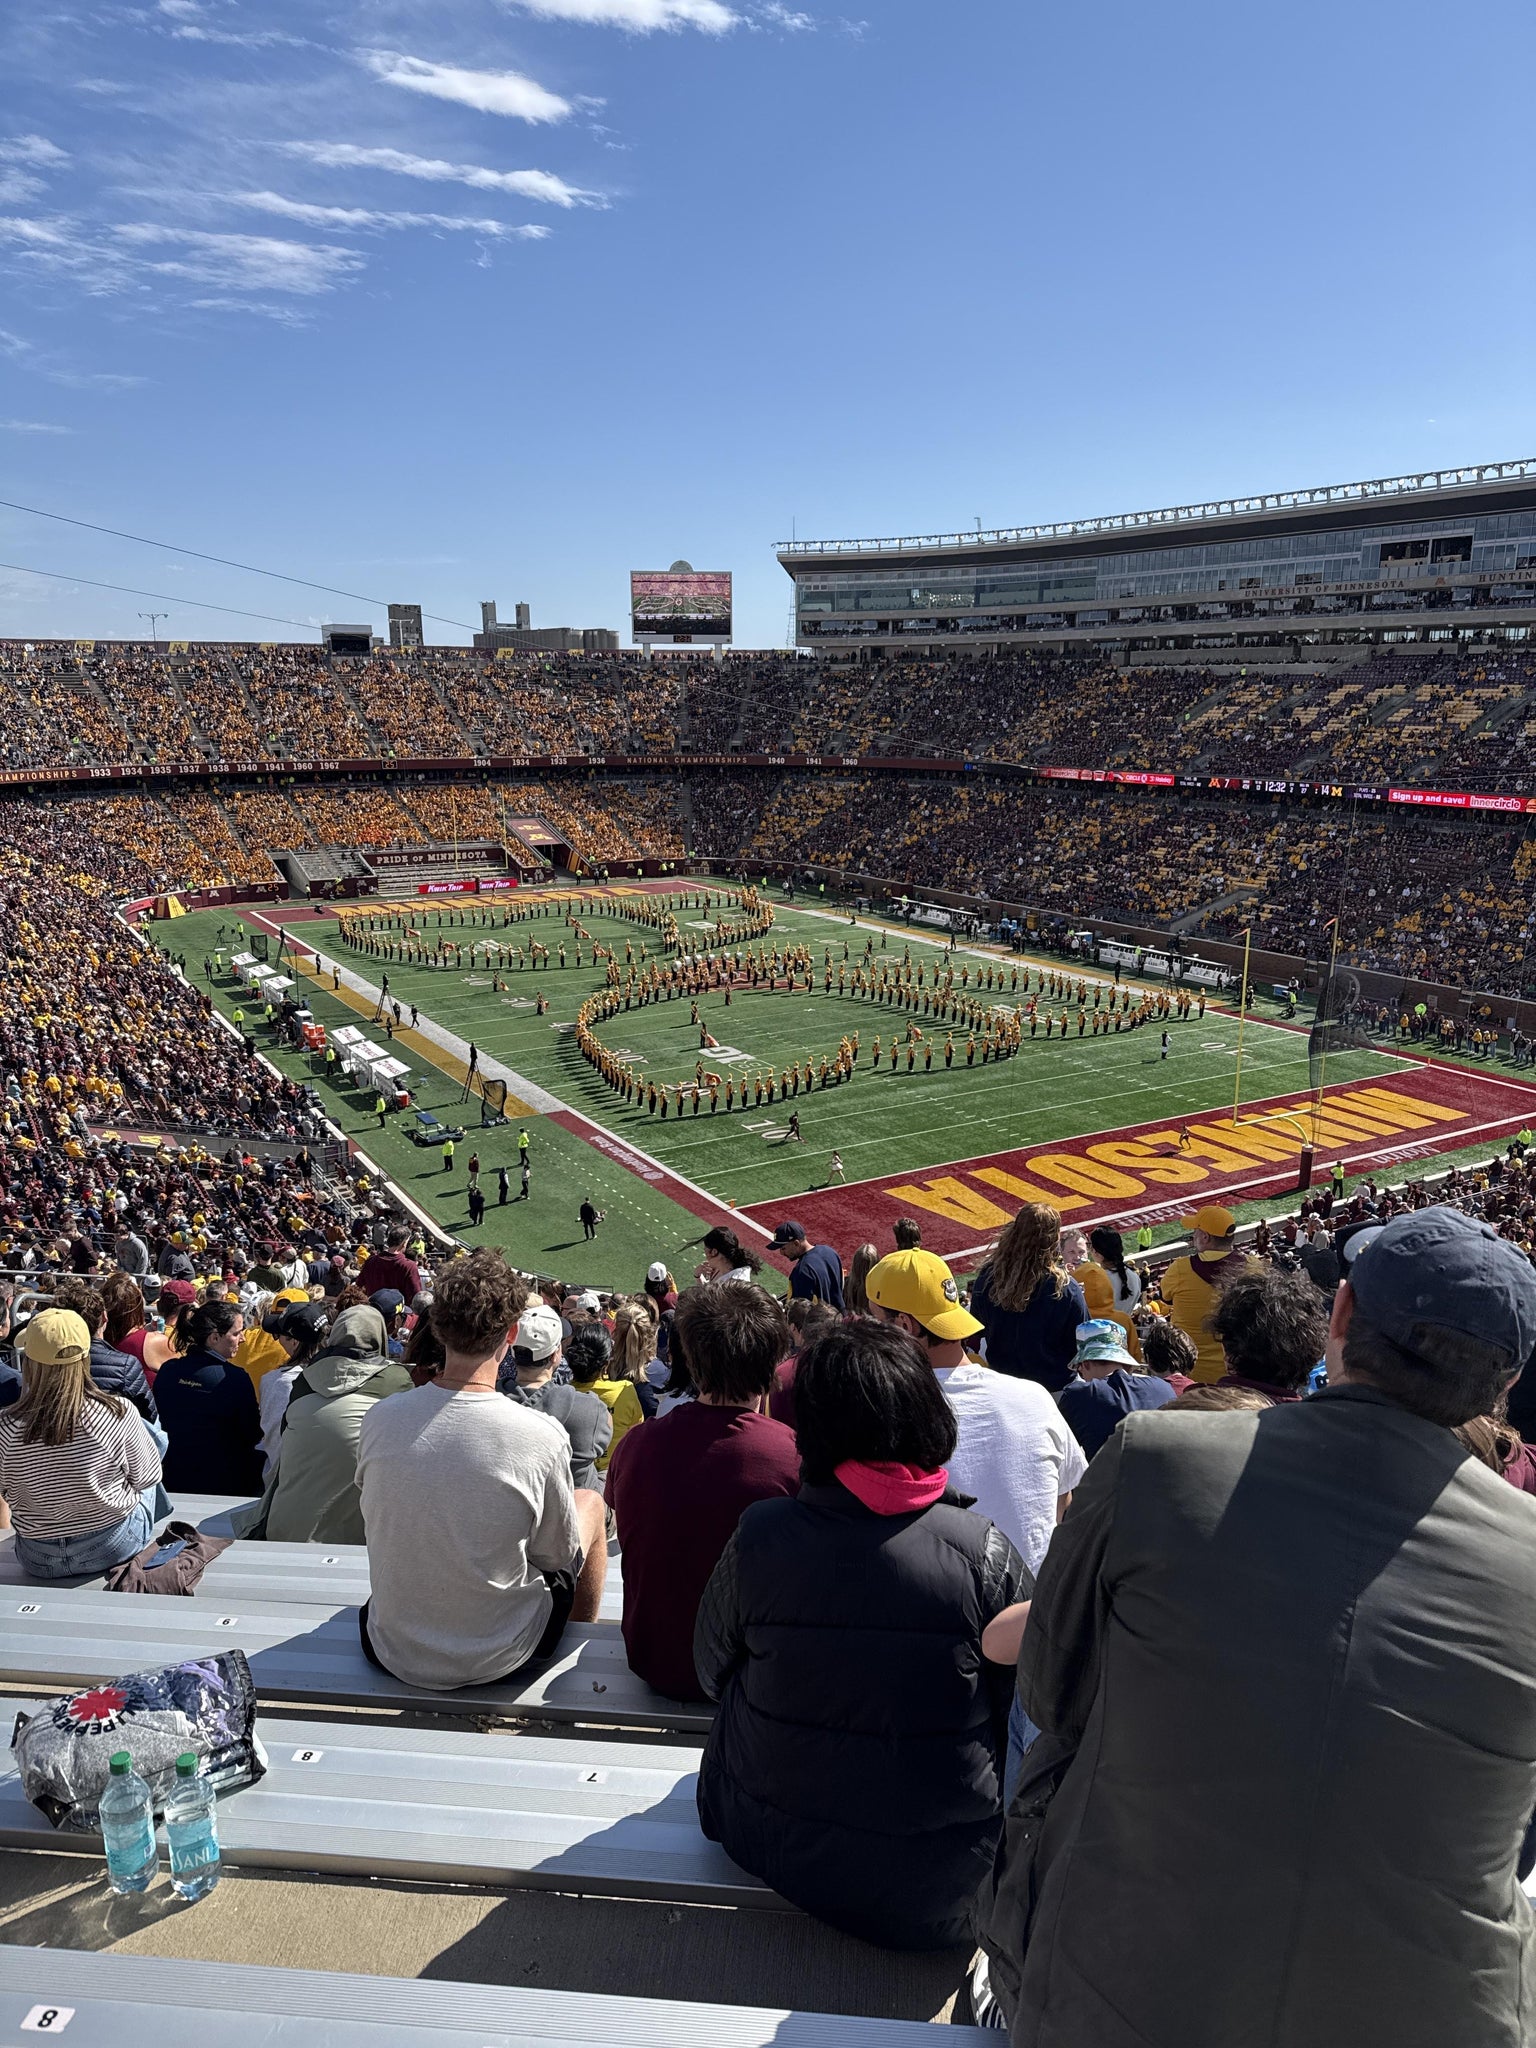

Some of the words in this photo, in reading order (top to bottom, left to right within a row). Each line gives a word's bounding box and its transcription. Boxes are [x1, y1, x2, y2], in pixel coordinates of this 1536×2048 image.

[1478, 571, 1536, 583] HUNTIN
[1245, 586, 1310, 598] UNIVERSITY
[1315, 585, 1330, 593] OF
[1335, 580, 1405, 591] MINNESOTA
[473, 759, 491, 767] 1904
[512, 758, 530, 766] 1934
[674, 756, 747, 764] CHAMPIONSHIPS
[806, 757, 822, 765] 1941
[842, 758, 858, 766] 1960
[90, 768, 111, 777] 1933
[121, 767, 142, 776] 1934
[150, 766, 171, 775] 1935
[179, 765, 200, 774] 1937
[208, 764, 229, 773] 1938
[237, 763, 257, 772] 1940
[265, 763, 285, 771] 1941
[293, 762, 313, 770] 1960
[319, 761, 340, 770] 1967
[1265, 781, 1287, 793] 12:32
[1321, 785, 1330, 795] 14
[1331, 786, 1343, 797] M
[1392, 791, 1411, 802] Sign
[1412, 794, 1424, 803] up
[1425, 794, 1441, 803] and
[1443, 796, 1466, 805] save!
[1470, 795, 1521, 810] innercircle
[376, 855, 408, 864] PRIDE
[428, 851, 488, 862] MINNESOTA
[267, 883, 279, 892] 25
[448, 883, 464, 892] TRIP
[495, 880, 510, 888] TRIP
[883, 1087, 1471, 1231] MINNESOTA
[302, 1752, 313, 1761] 8
[586, 1772, 598, 1782] 7
[37, 2009, 59, 2028] 8
